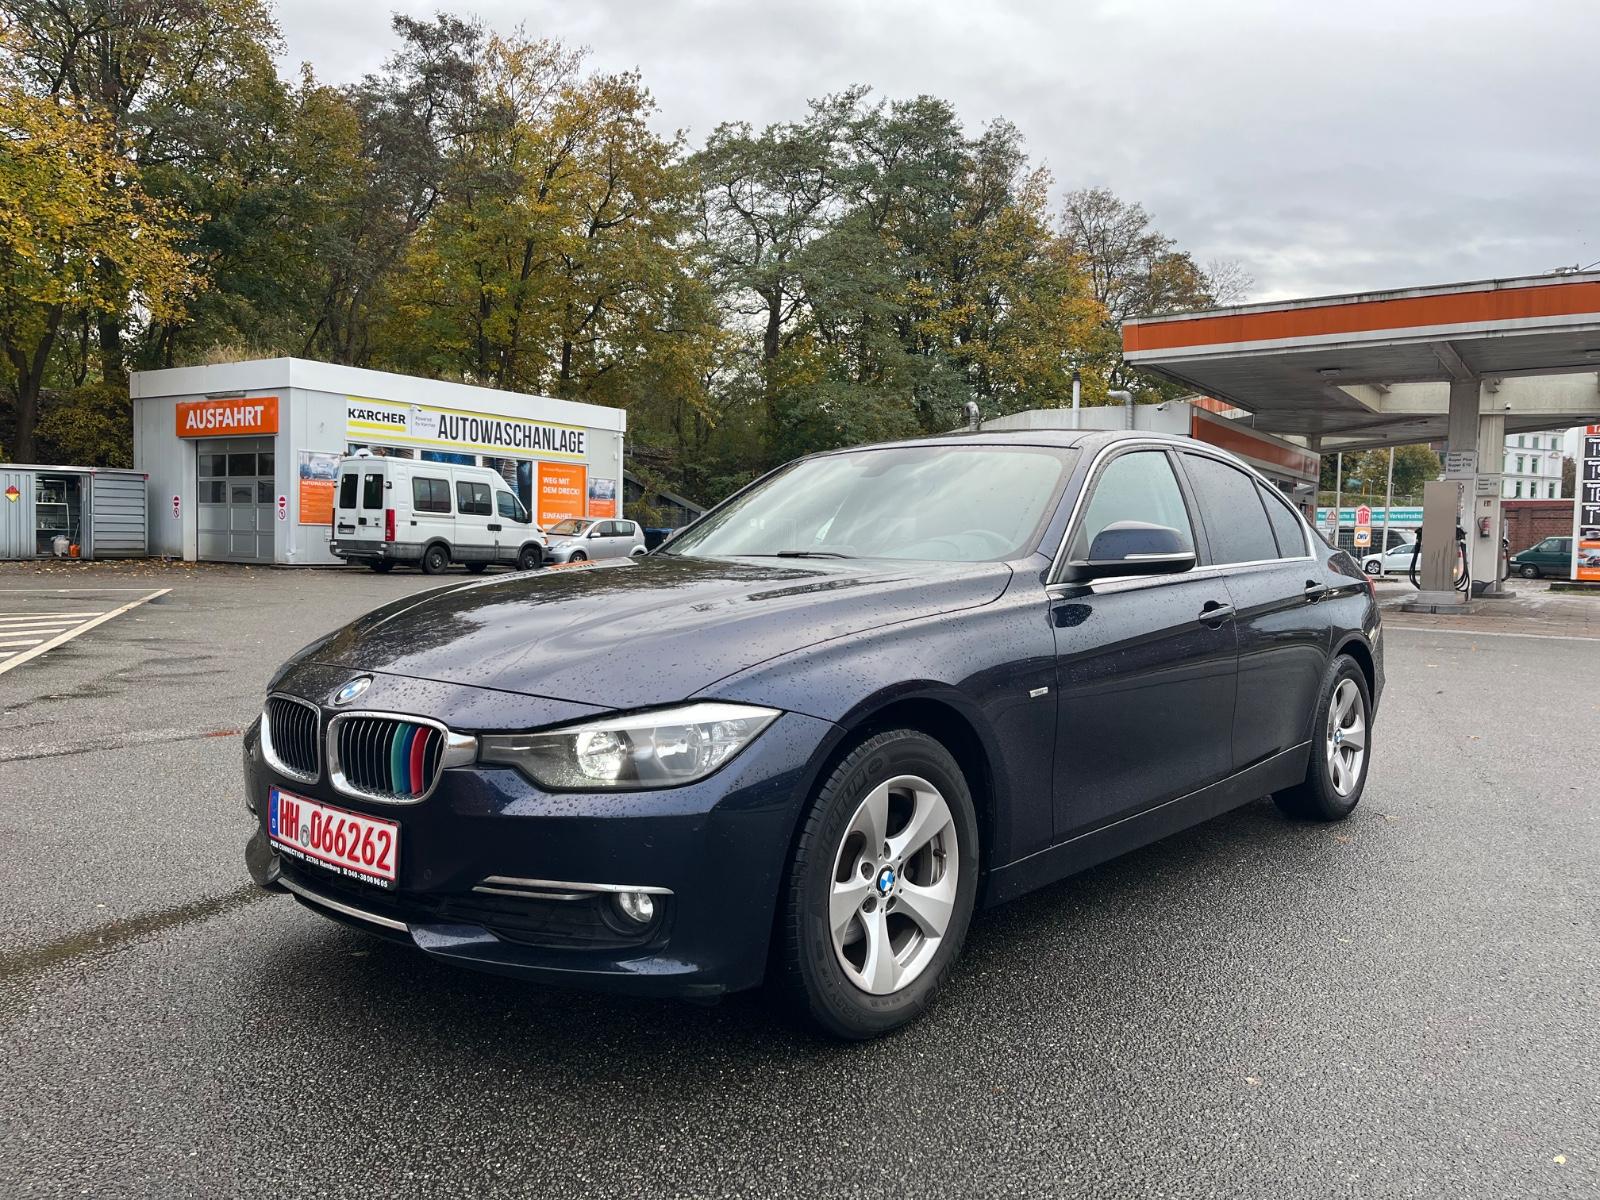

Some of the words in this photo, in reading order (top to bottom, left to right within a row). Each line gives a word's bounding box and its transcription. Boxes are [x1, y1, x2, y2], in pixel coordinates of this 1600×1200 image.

[186, 406, 264, 429] AUSFAHRT
[348, 408, 406, 424] KÄRCHER
[438, 414, 584, 454] AUTOWASCHANLAGE
[543, 512, 572, 520] EINFAHRT
[280, 799, 300, 841] HH
[310, 810, 392, 872] 066262
